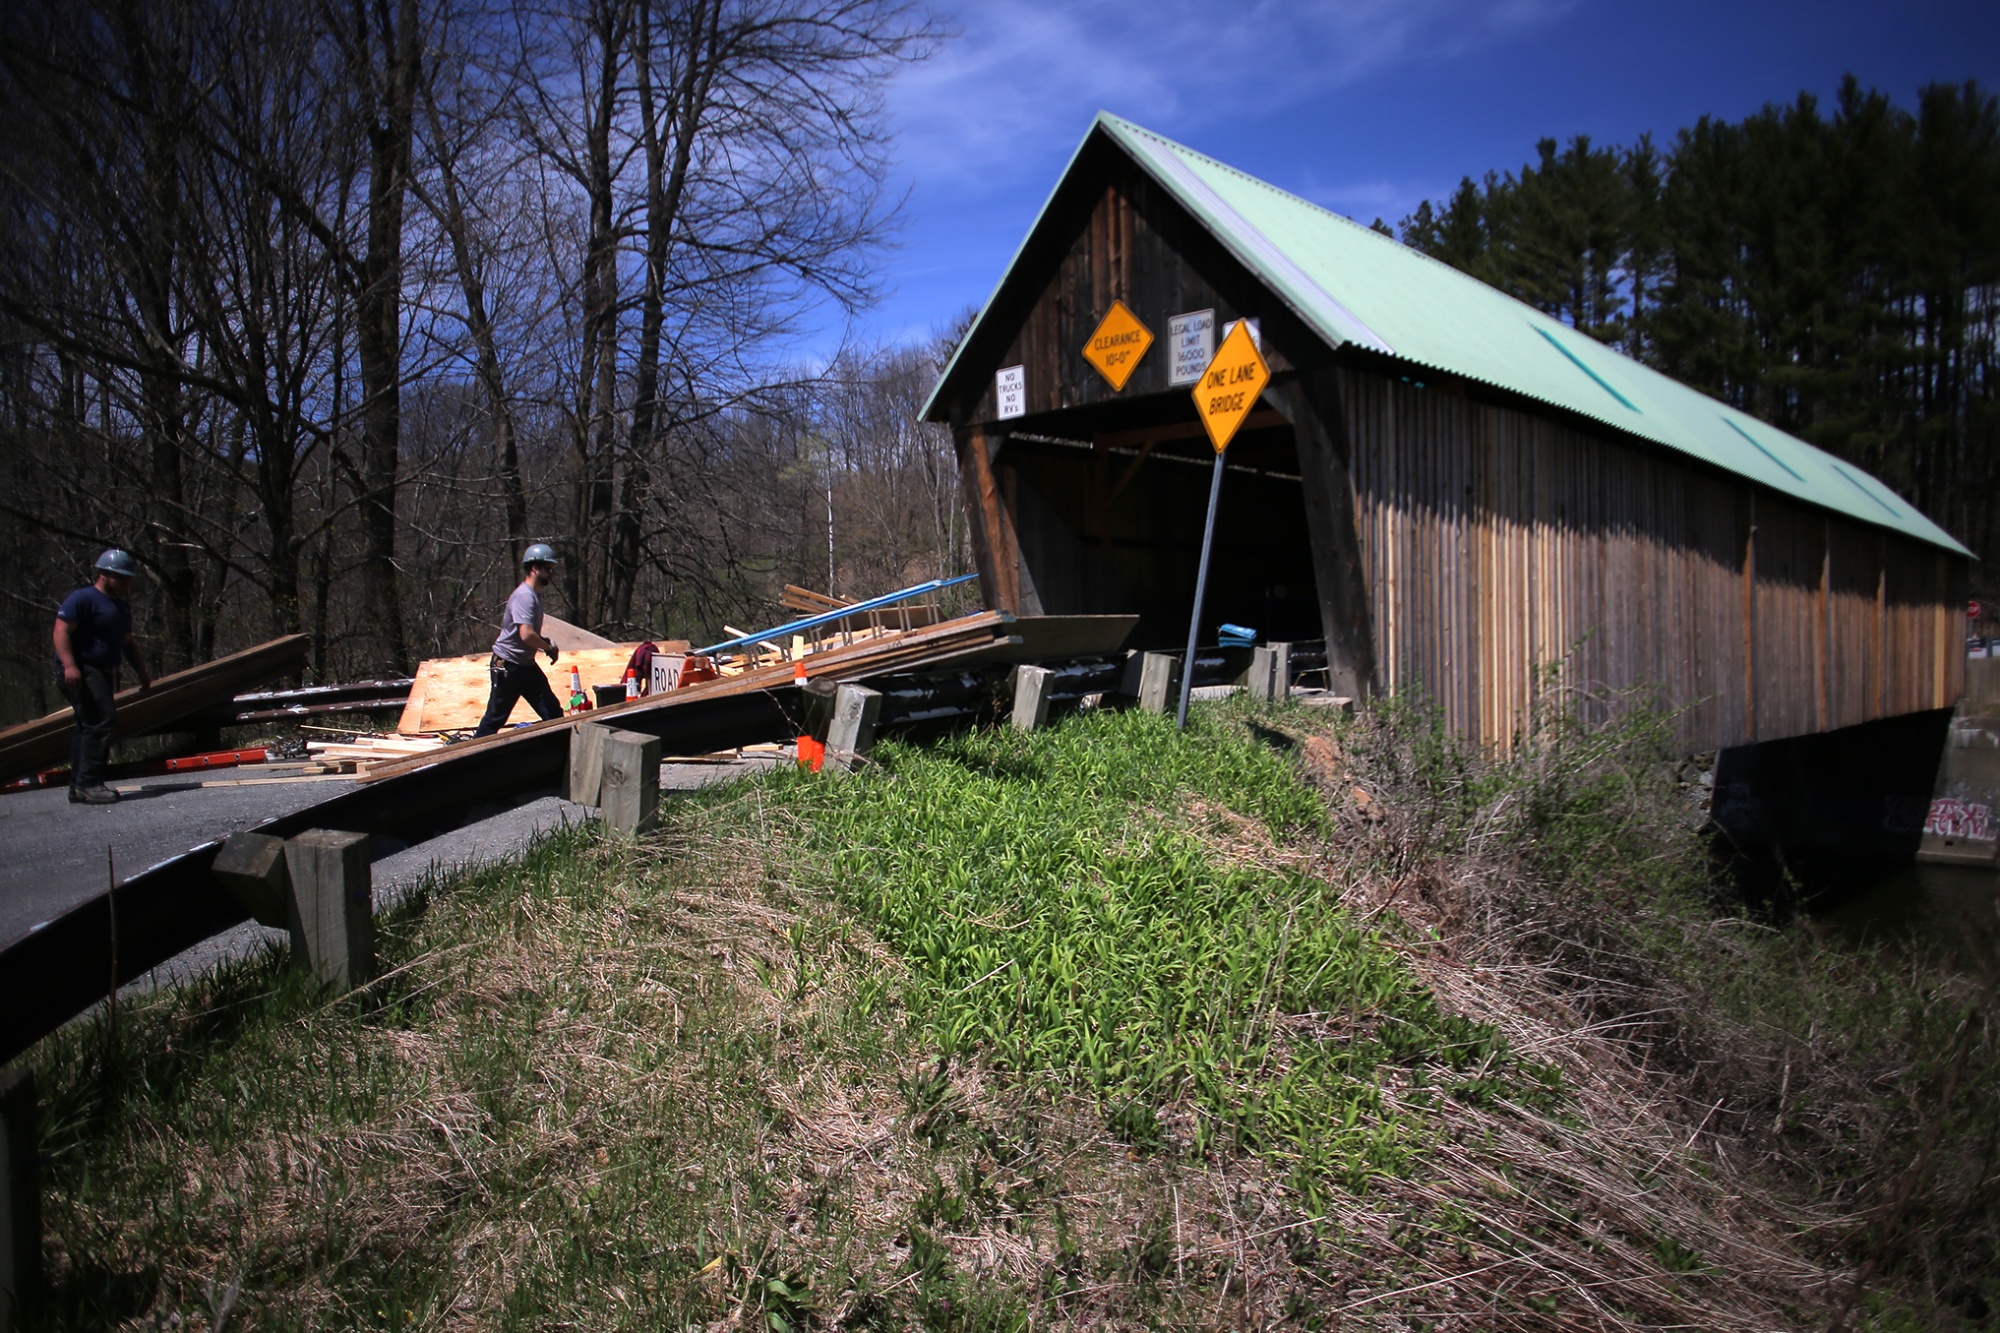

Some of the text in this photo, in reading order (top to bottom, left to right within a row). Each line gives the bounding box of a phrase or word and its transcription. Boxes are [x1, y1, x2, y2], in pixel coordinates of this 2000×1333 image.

[1170, 317, 1212, 335] LEGAL LOAD
[1094, 329, 1141, 350] CLEARANCE
[1181, 334, 1201, 347] LIMIT
[1177, 347, 1206, 362] 16000
[1175, 361, 1207, 376] POUNDS
[1207, 361, 1256, 389] ONE LANE
[1004, 372, 1015, 382] NO
[999, 381, 1023, 393] TRUCKS
[1006, 393, 1016, 403] NO
[1209, 391, 1245, 415] BRIDGE
[654, 667, 679, 692] ROAD
